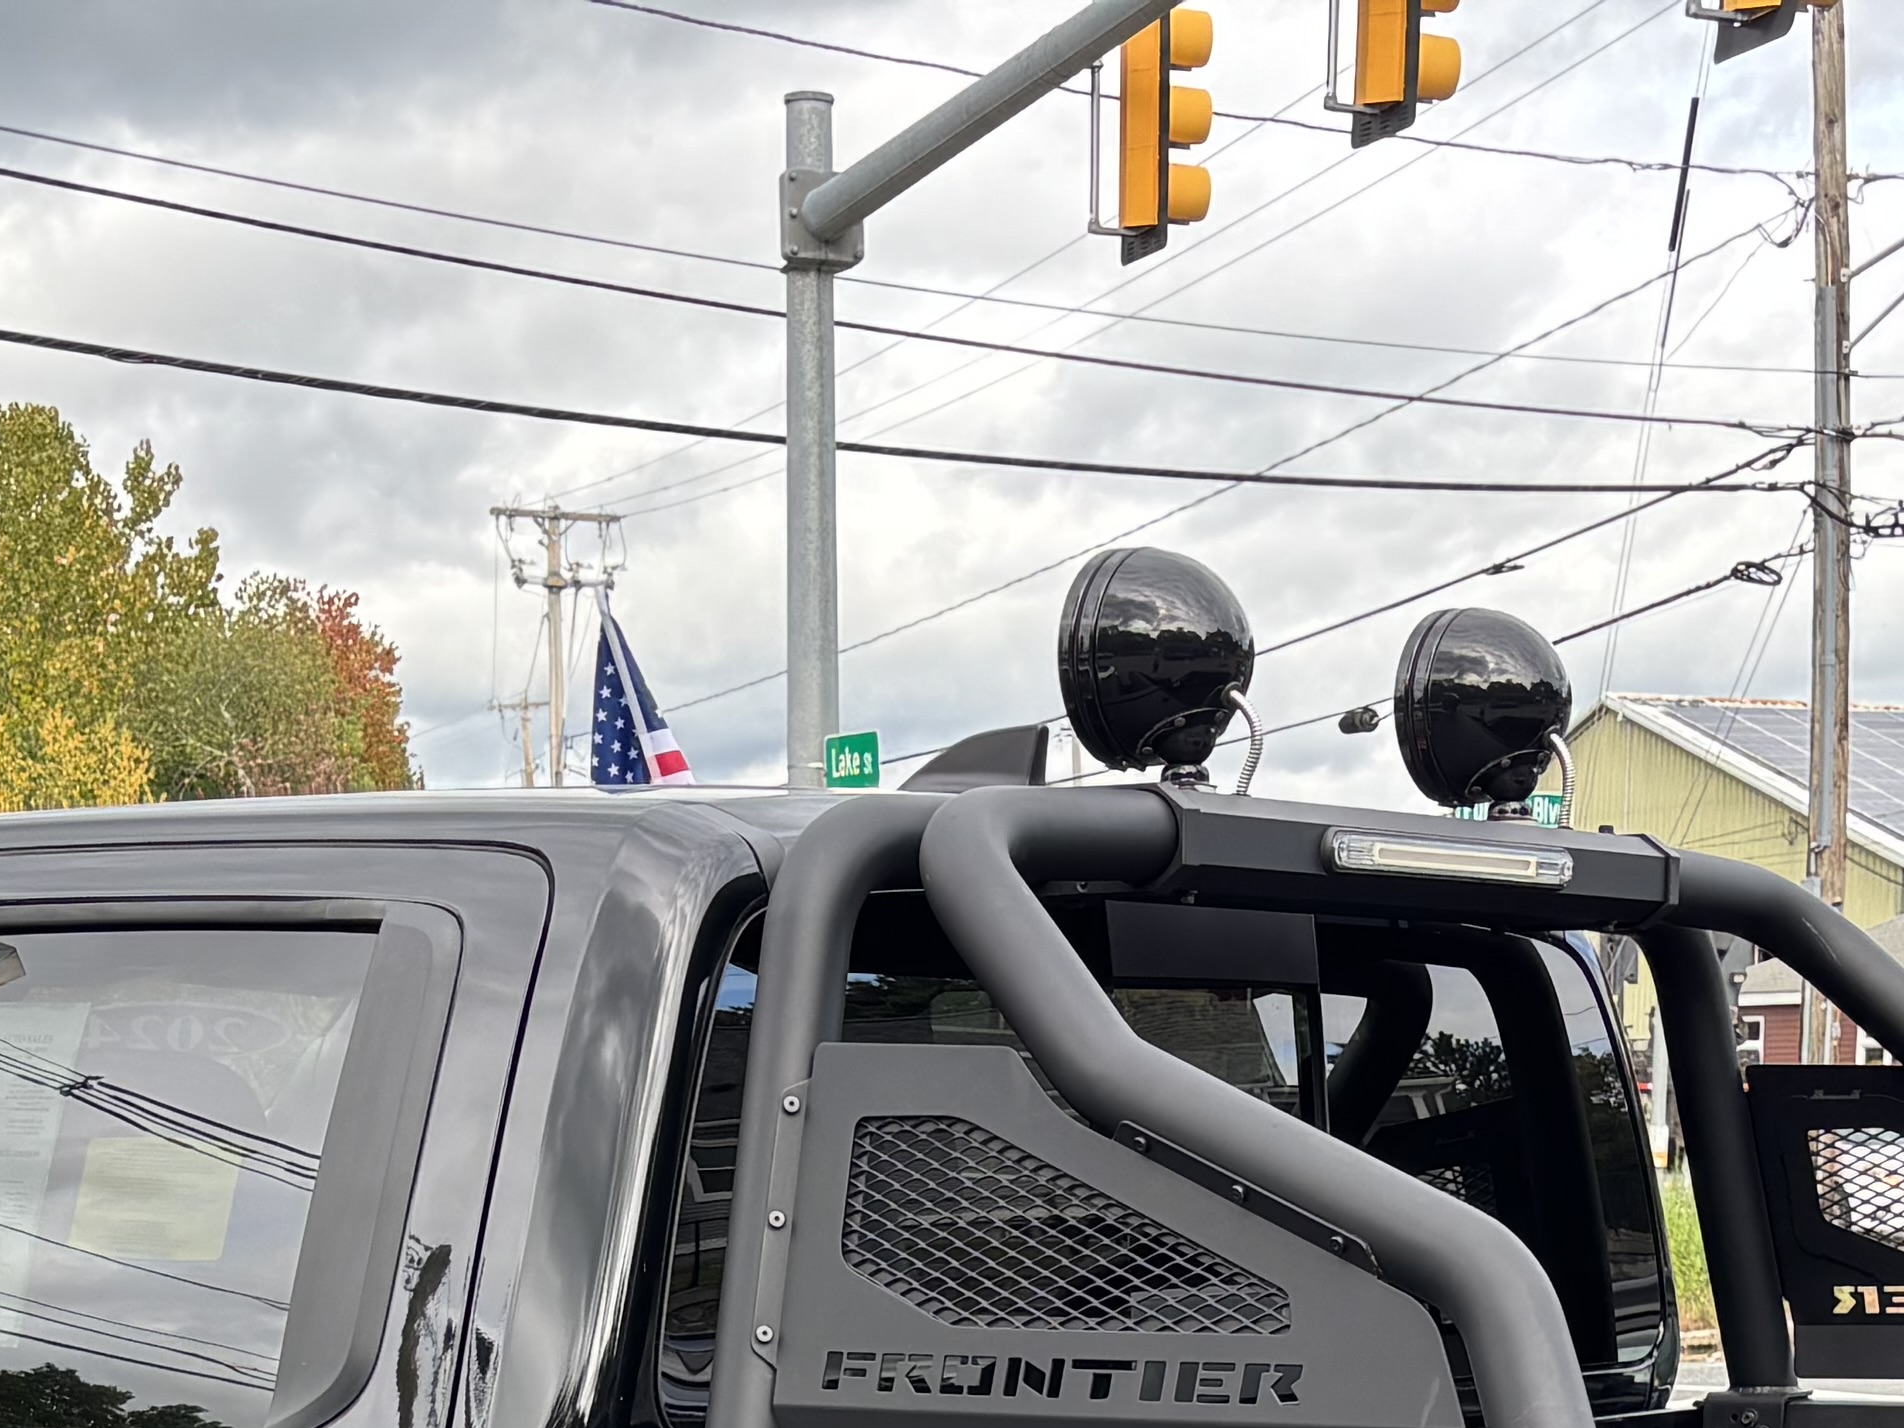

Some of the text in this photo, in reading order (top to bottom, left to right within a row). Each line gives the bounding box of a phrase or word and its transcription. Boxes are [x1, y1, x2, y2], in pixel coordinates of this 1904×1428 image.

[831, 747, 860, 778] Lake
[1532, 796, 1560, 825] Blv
[821, 1350, 1304, 1407] FRONTIER
